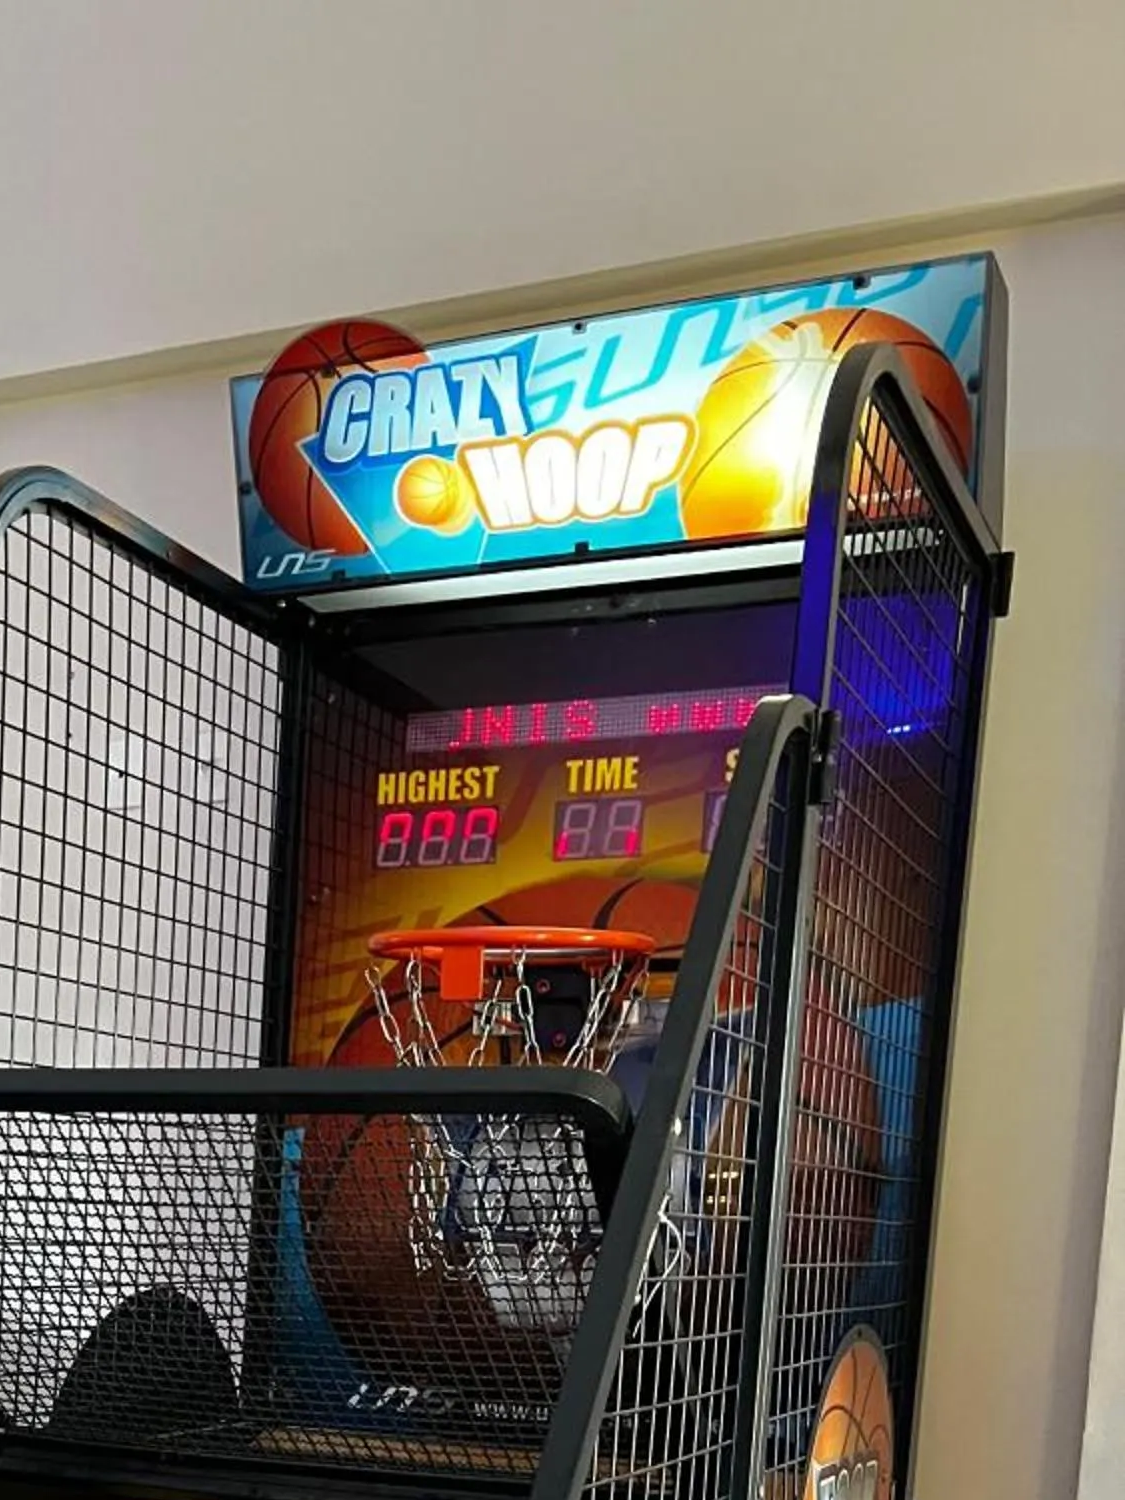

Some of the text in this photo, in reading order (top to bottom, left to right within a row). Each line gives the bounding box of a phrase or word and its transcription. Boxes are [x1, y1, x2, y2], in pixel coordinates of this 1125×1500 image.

[324, 354, 529, 463] CRAZY
[463, 422, 687, 528] HOOP
[377, 764, 500, 805] HIGHEST
[565, 755, 641, 794] TIME
